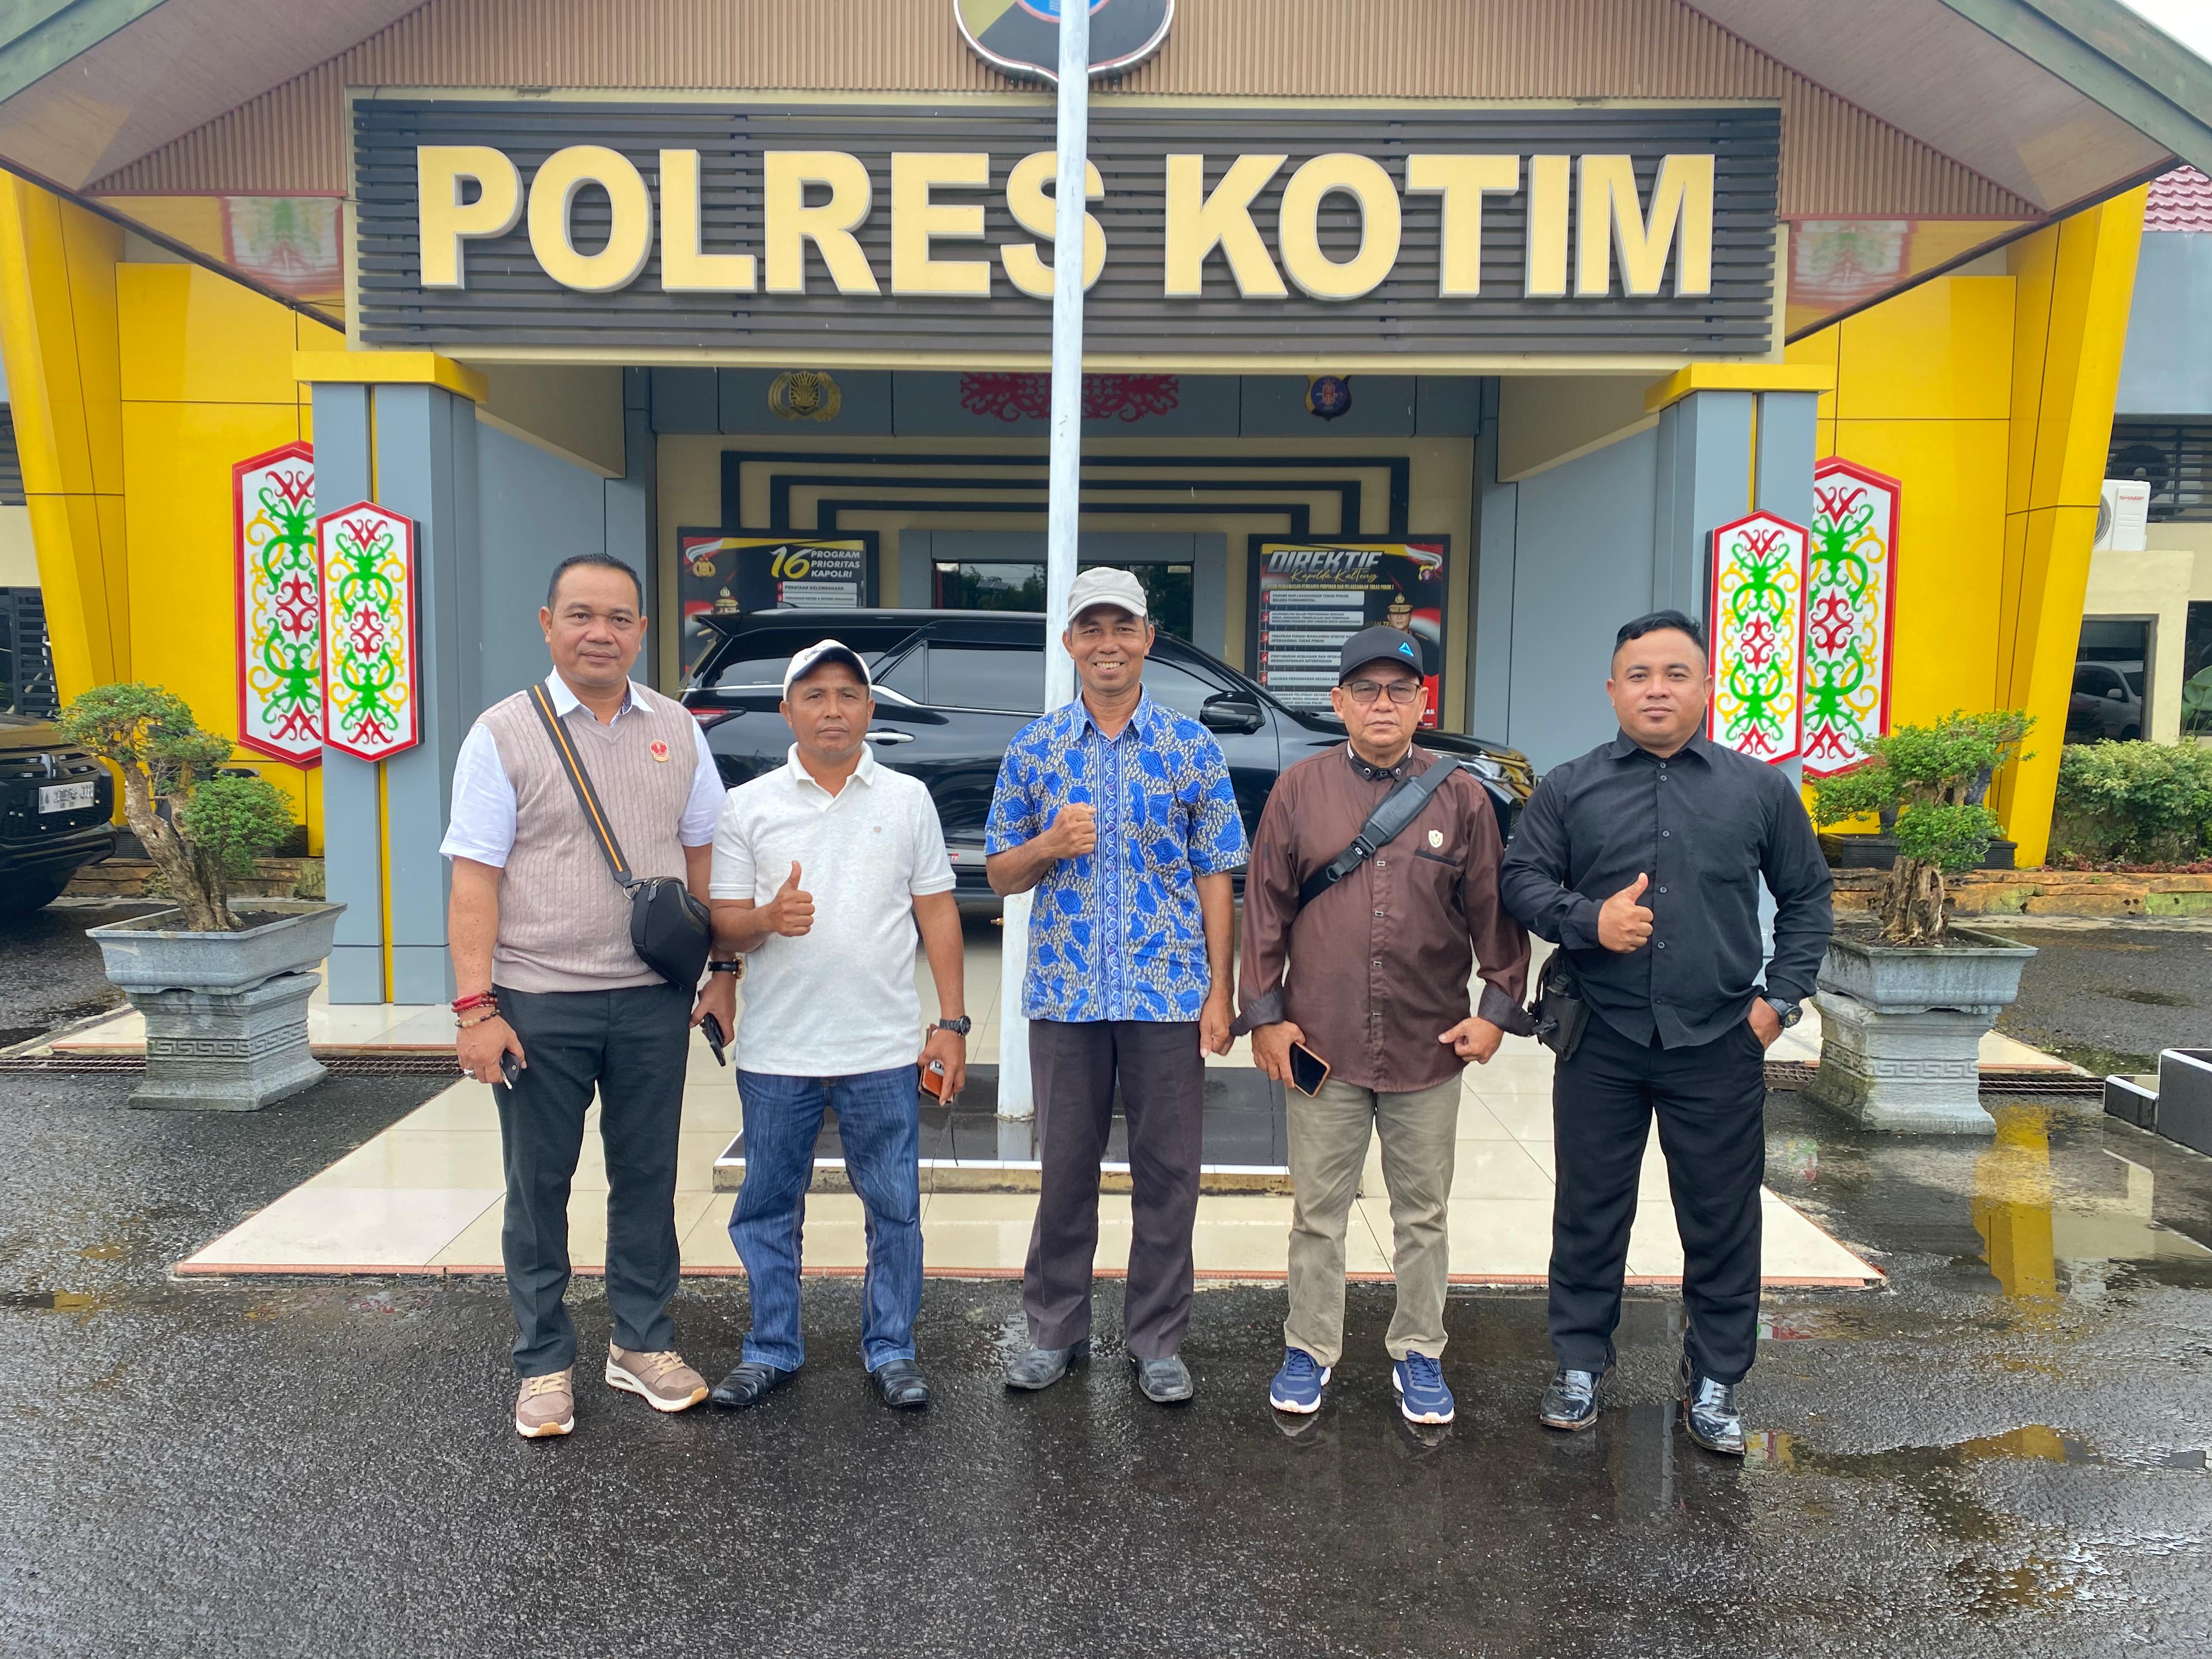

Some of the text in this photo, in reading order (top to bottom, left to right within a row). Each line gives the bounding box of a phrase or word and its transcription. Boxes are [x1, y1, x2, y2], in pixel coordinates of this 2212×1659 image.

[415, 144, 1716, 301] POLRES KOTIM
[811, 550, 860, 558] PROGRAM
[769, 546, 816, 579] 16
[811, 560, 860, 568] PRIORITAS
[1267, 551, 1384, 573] DIREKTIF
[811, 569, 853, 578] KAPOLRI
